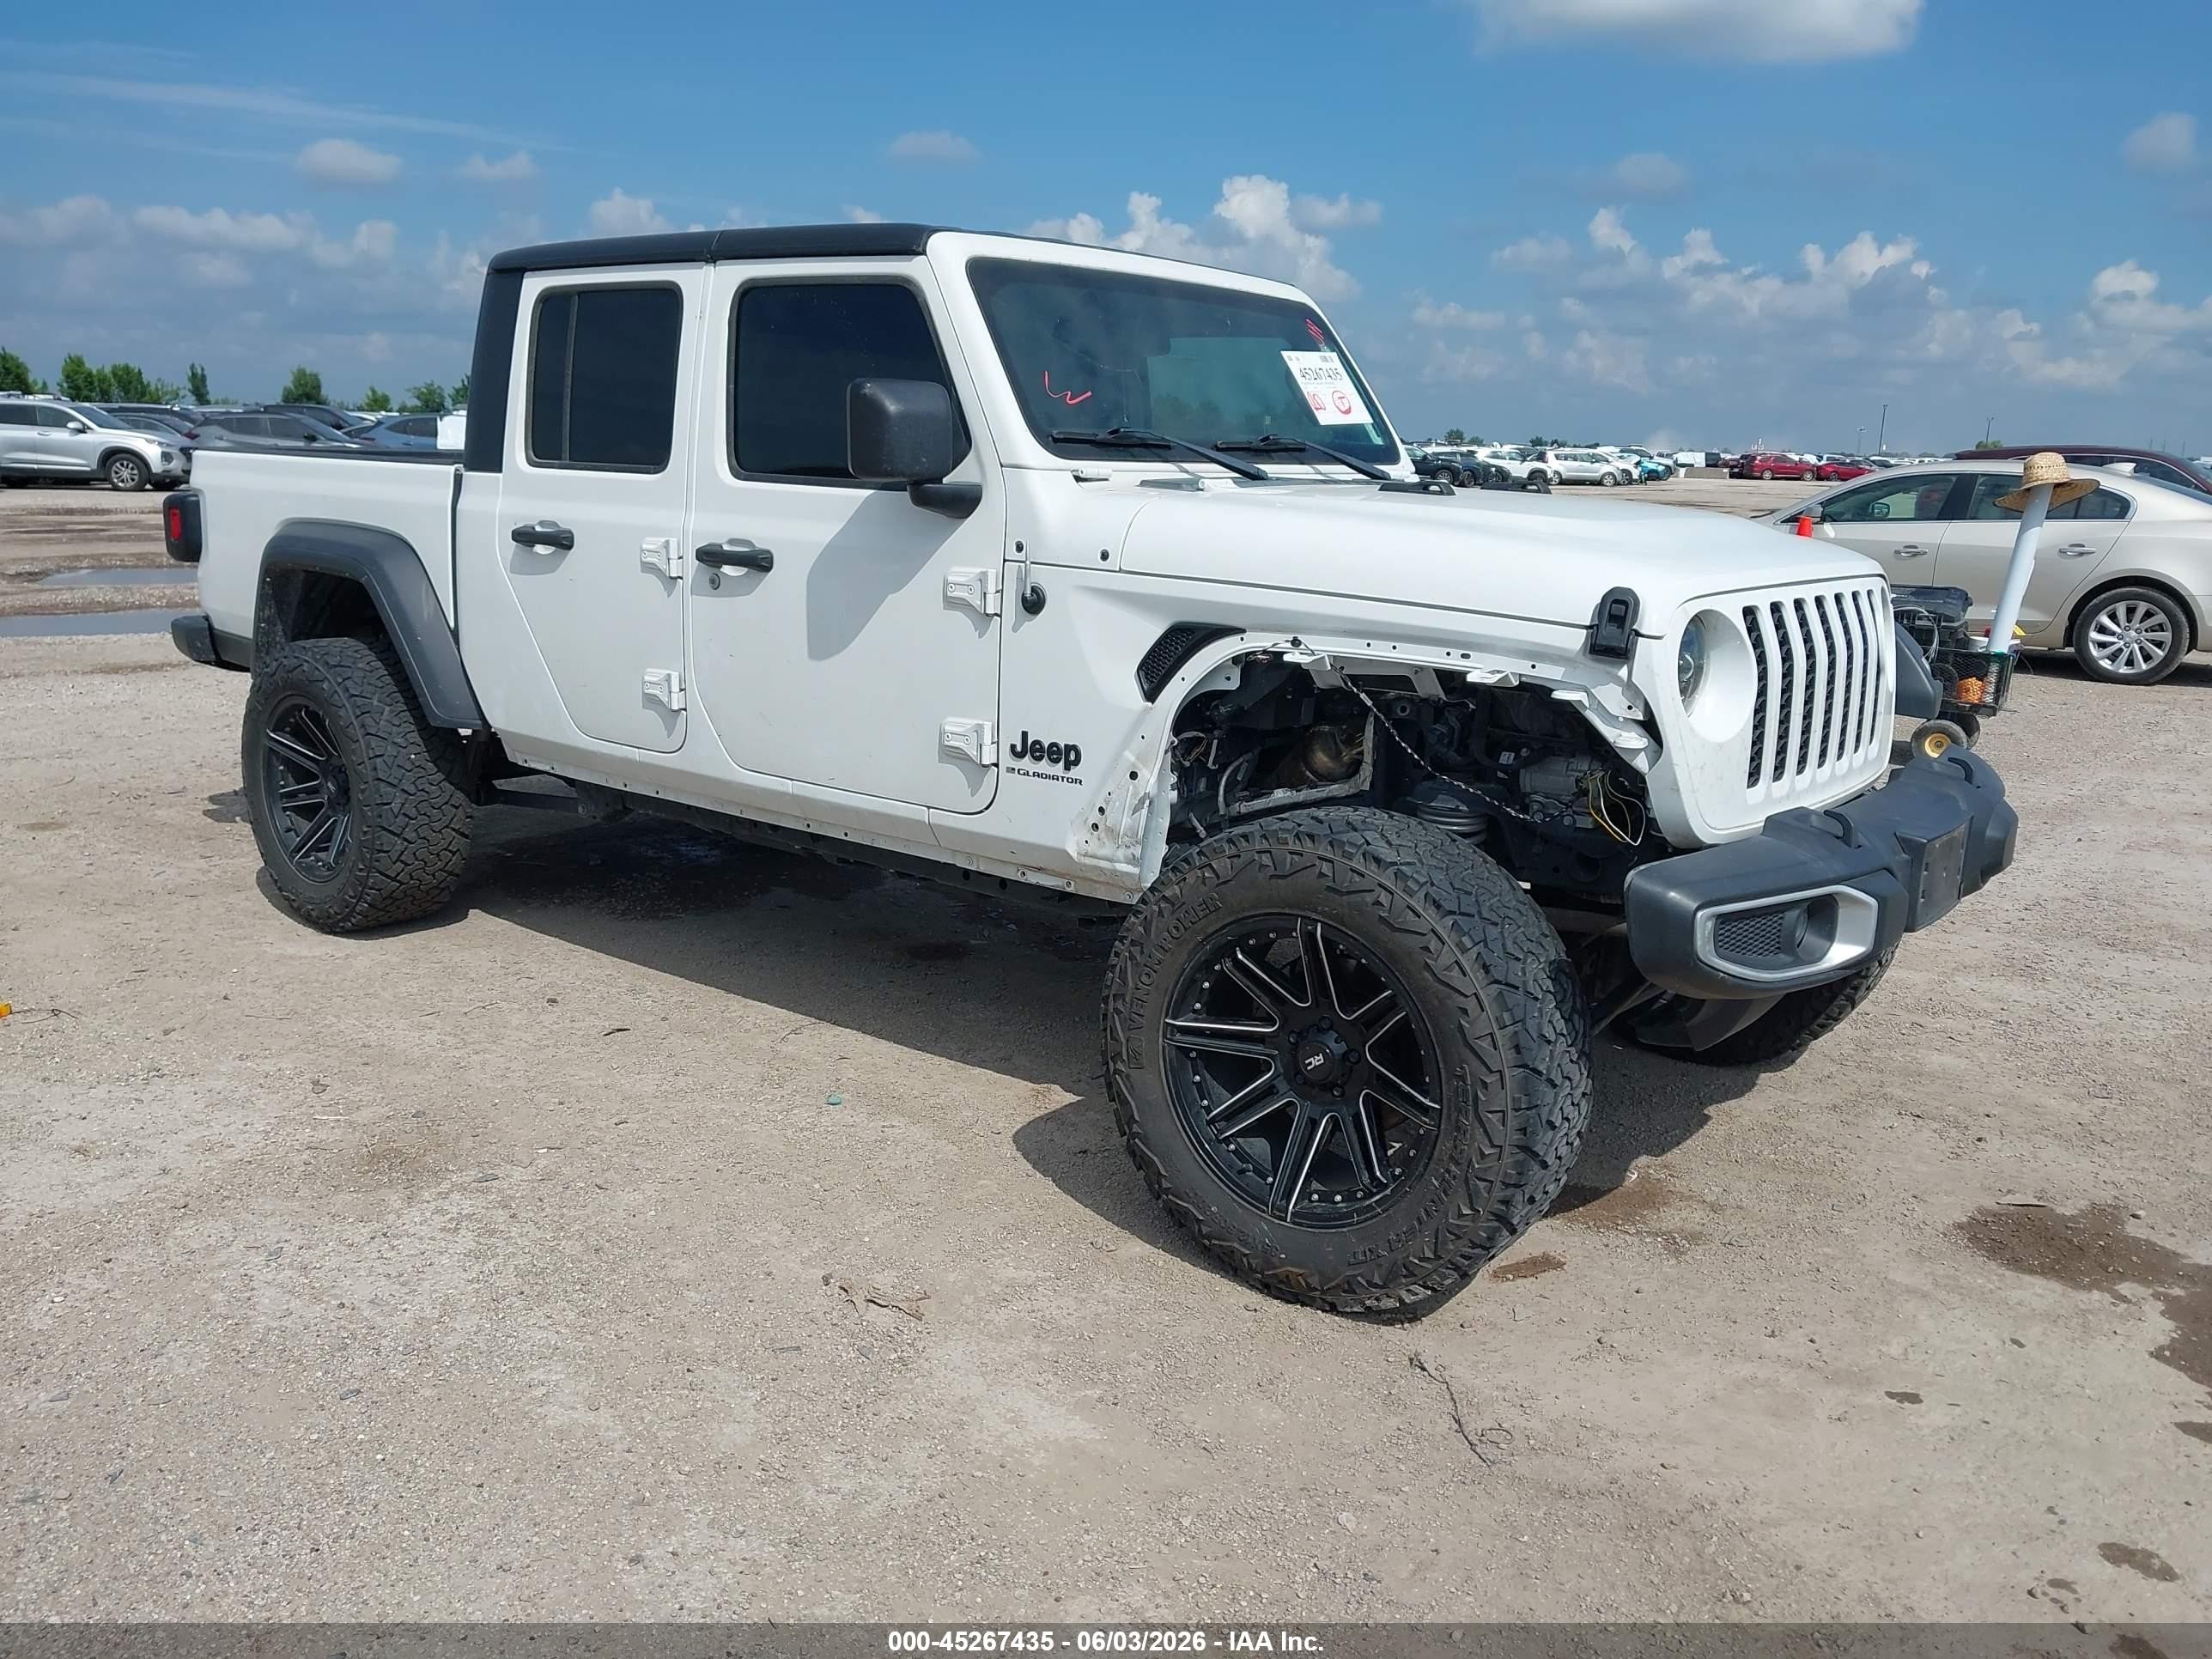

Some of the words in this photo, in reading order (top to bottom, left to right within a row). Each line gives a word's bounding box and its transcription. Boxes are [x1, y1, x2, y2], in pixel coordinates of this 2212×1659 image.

[1299, 367, 1343, 381] 45267435
[1010, 730, 1082, 771] Jeep
[1017, 768, 1084, 786] GLADIATOR
